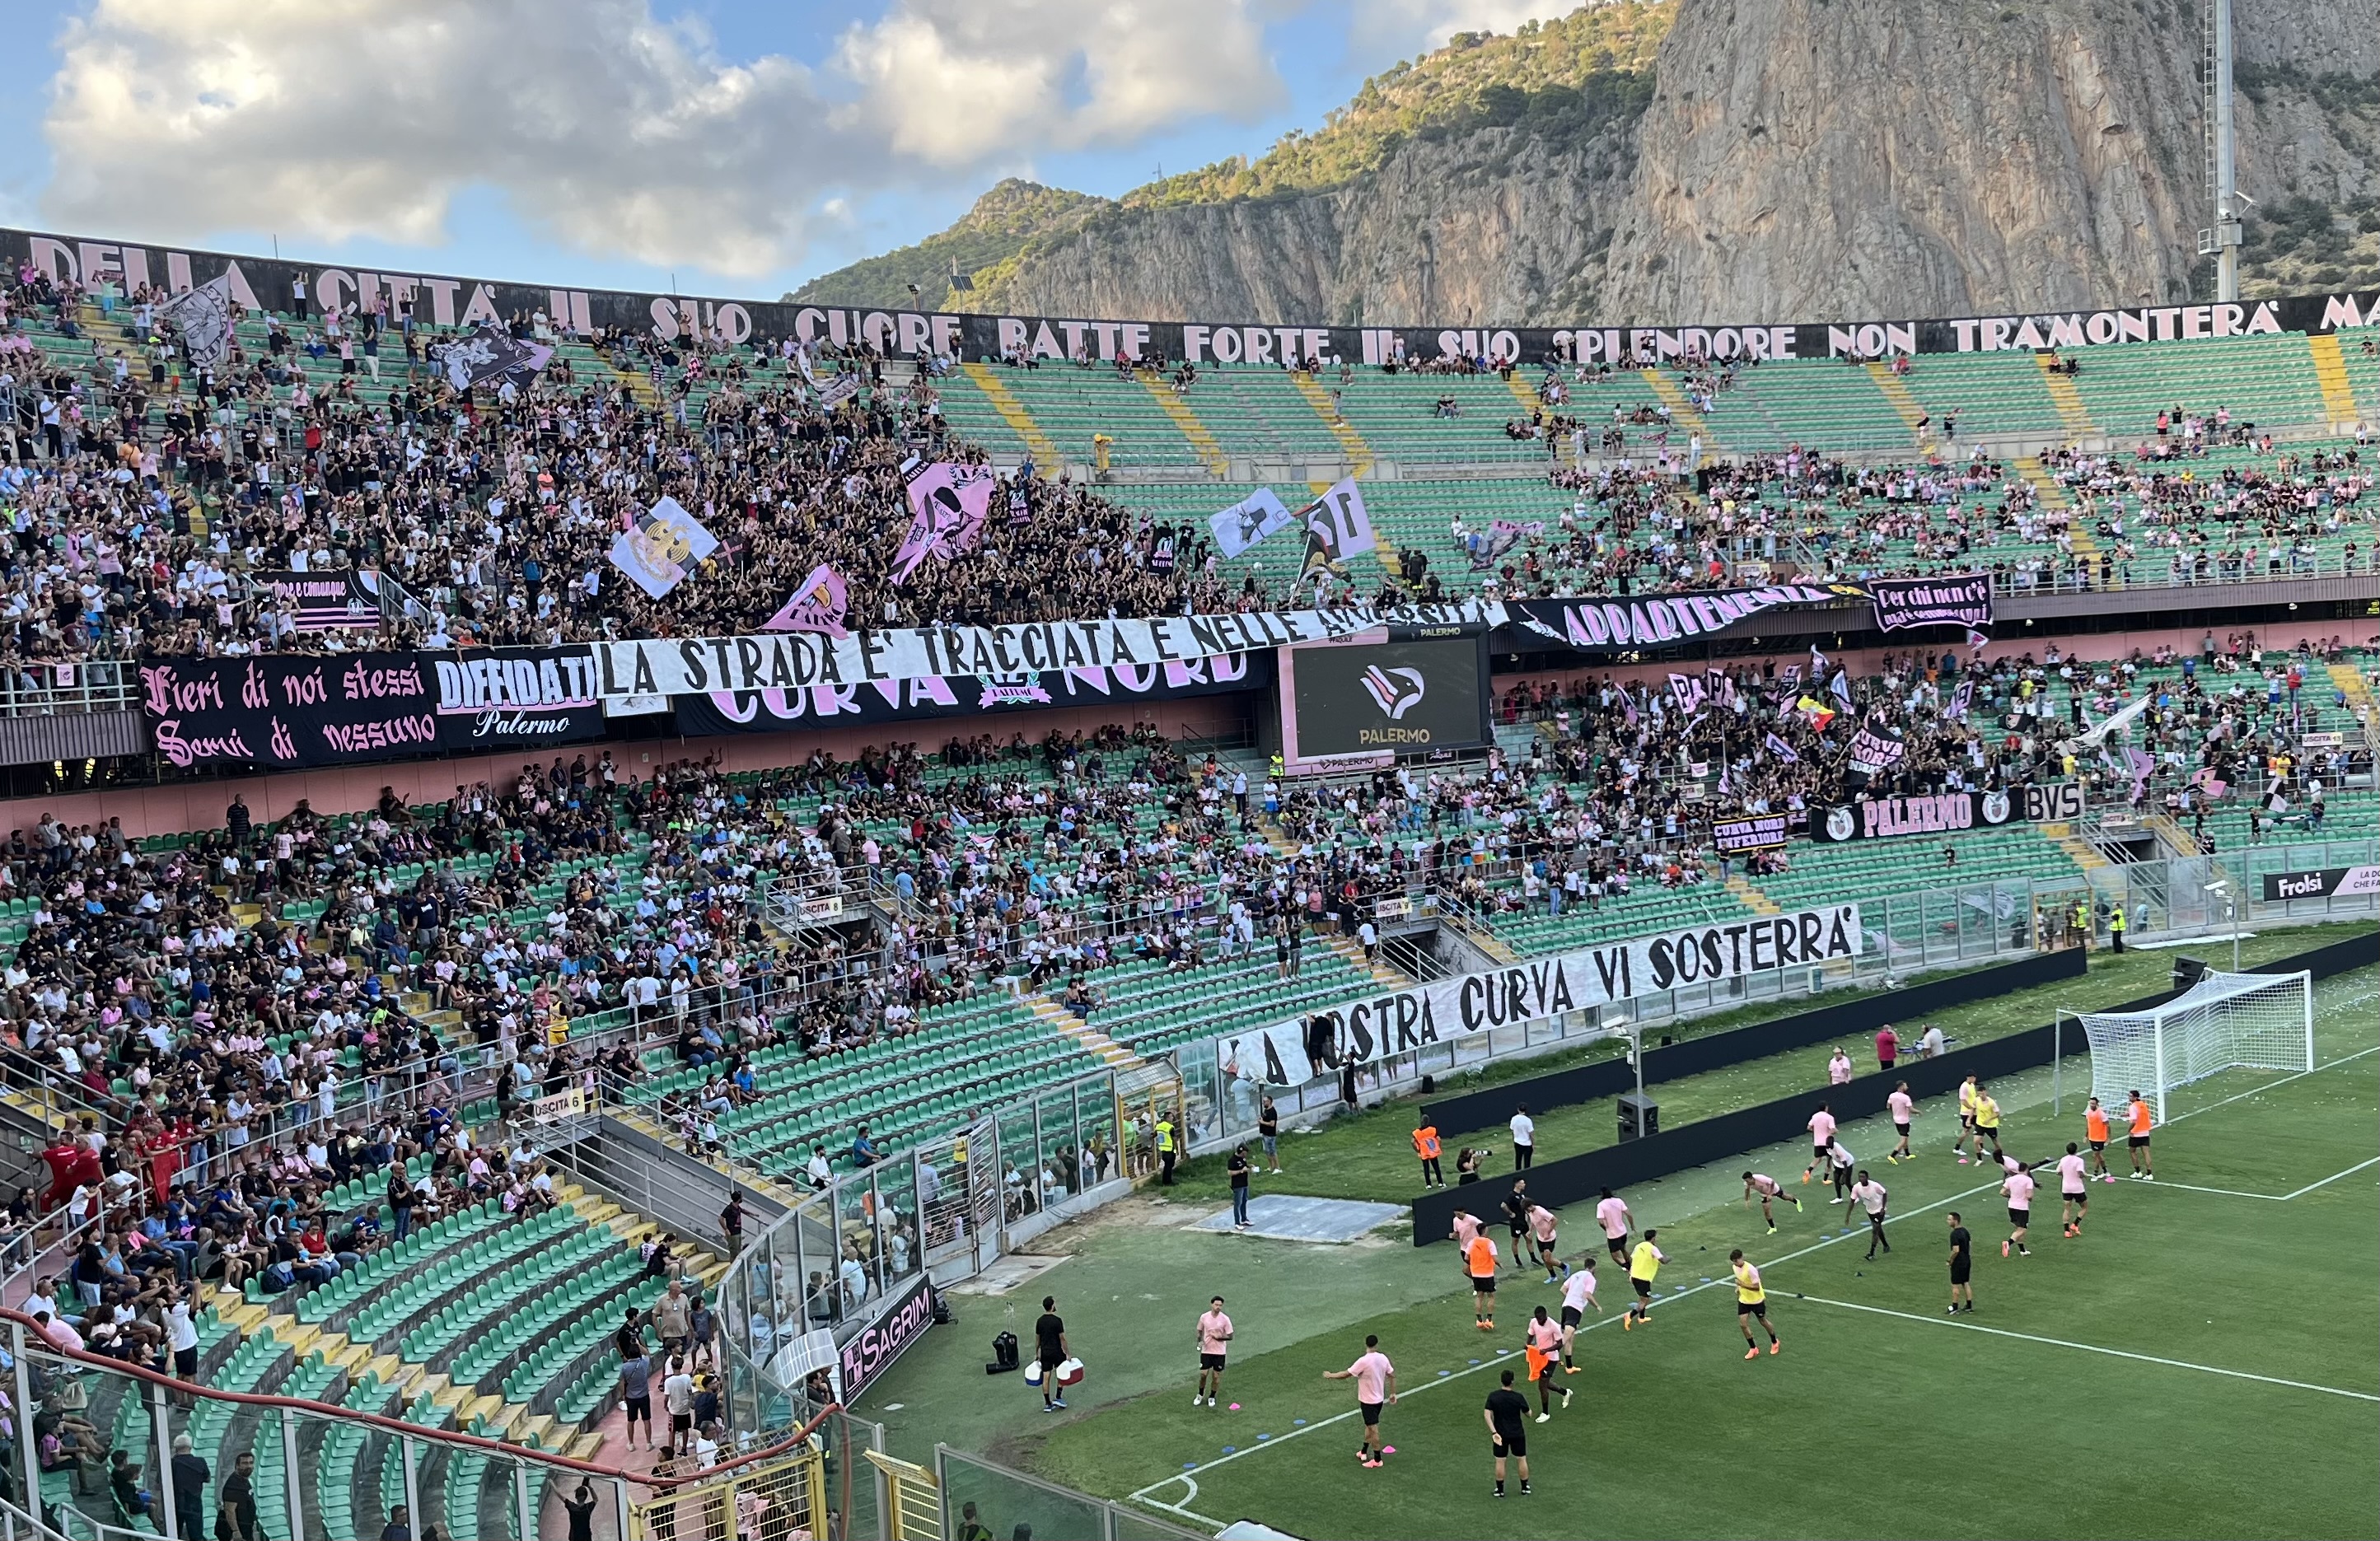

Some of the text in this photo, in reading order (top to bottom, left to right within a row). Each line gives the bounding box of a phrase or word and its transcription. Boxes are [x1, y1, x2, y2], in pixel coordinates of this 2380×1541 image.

[549, 289, 605, 335] IL
[648, 297, 752, 344] SUO
[794, 307, 961, 354] CUORE
[998, 318, 1150, 362] BATTE
[1438, 329, 1520, 365] SUO
[1553, 327, 1797, 365] SPLENDORE
[1828, 323, 1915, 357] NON
[1877, 588, 1905, 608] Per
[1908, 586, 1933, 605] chi
[1933, 587, 1965, 604] non
[1420, 627, 1461, 637] PALERMO
[601, 641, 657, 694] LA
[679, 635, 843, 692] STRADA
[914, 619, 1137, 675] TRACCIATA
[1151, 619, 1180, 661] E
[1185, 612, 1310, 655] NELLE
[139, 660, 425, 717] Fieri di noi stessi
[434, 656, 597, 709] DIFFIDATI
[472, 705, 572, 739] Palermo
[271, 716, 297, 760] di
[322, 713, 436, 753] nessuno
[1359, 728, 1430, 745] PALERMO
[1332, 757, 1374, 768] PALERMO
[1862, 792, 1972, 838] PALERMO
[1714, 818, 1785, 838] CURVA NORD
[1716, 832, 1784, 850] INFERIORE
[2277, 872, 2323, 898] Frolsi
[2354, 880, 2370, 889] CHE
[800, 903, 838, 915] USCITA 8
[1377, 901, 1401, 912] USCITA
[1460, 959, 1574, 1031] CURVA
[1592, 946, 1631, 1001] VI
[535, 1096, 579, 1117] USCITA 6
[863, 1287, 930, 1374] SAGRIM
